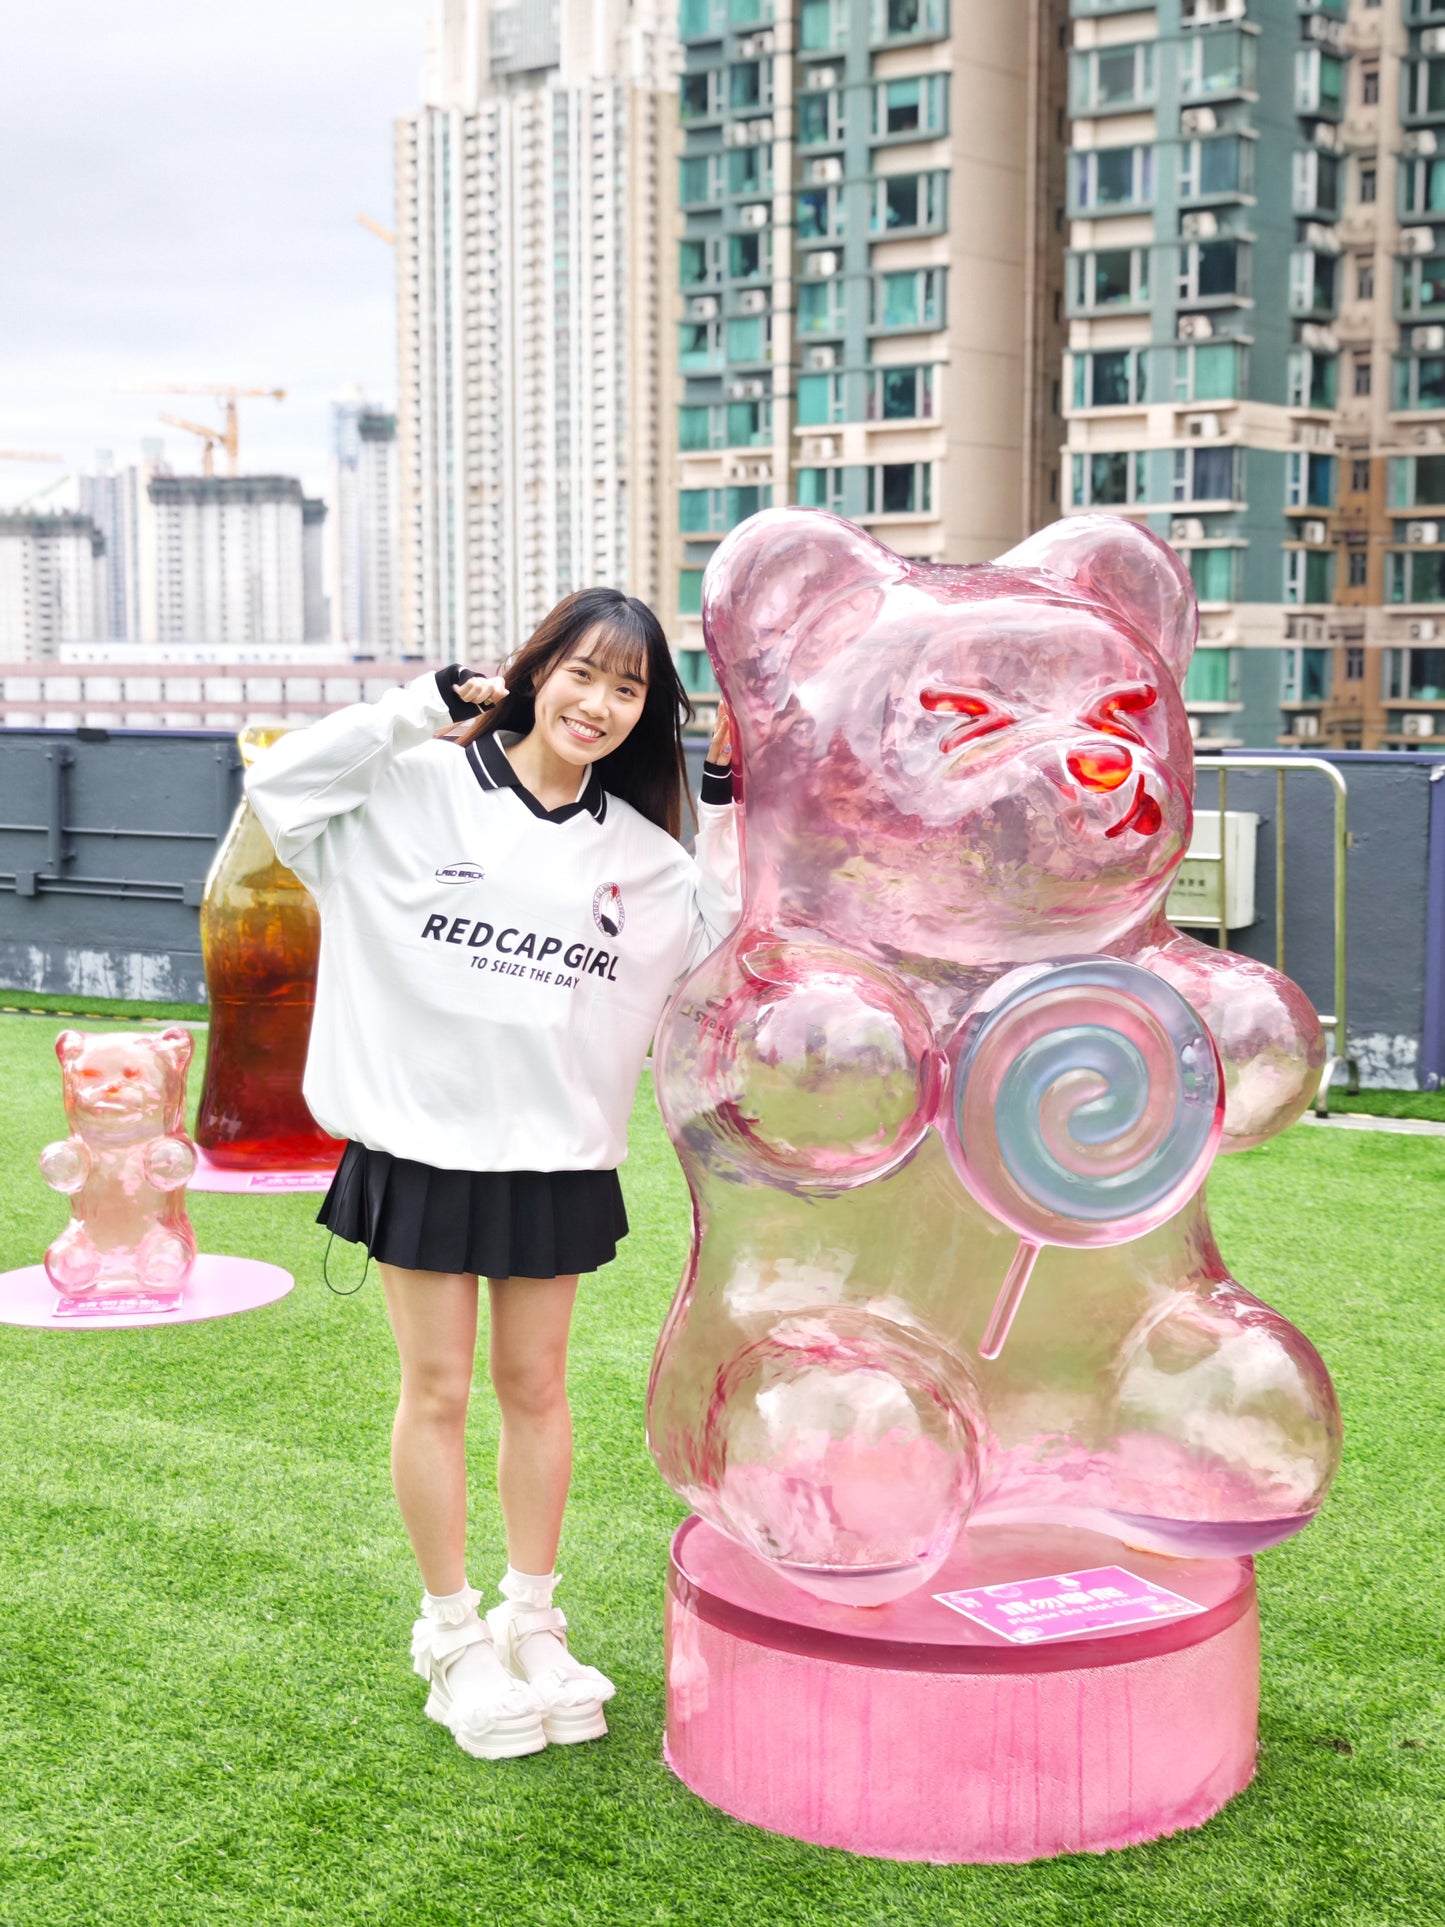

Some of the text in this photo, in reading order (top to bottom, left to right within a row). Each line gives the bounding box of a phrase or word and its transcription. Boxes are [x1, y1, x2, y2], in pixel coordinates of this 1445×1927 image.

[435, 869, 485, 880] LAID BACK
[470, 956, 580, 989] TO SEIZE THE DAY
[1008, 1594, 1159, 1625] Please Do Not Climb
